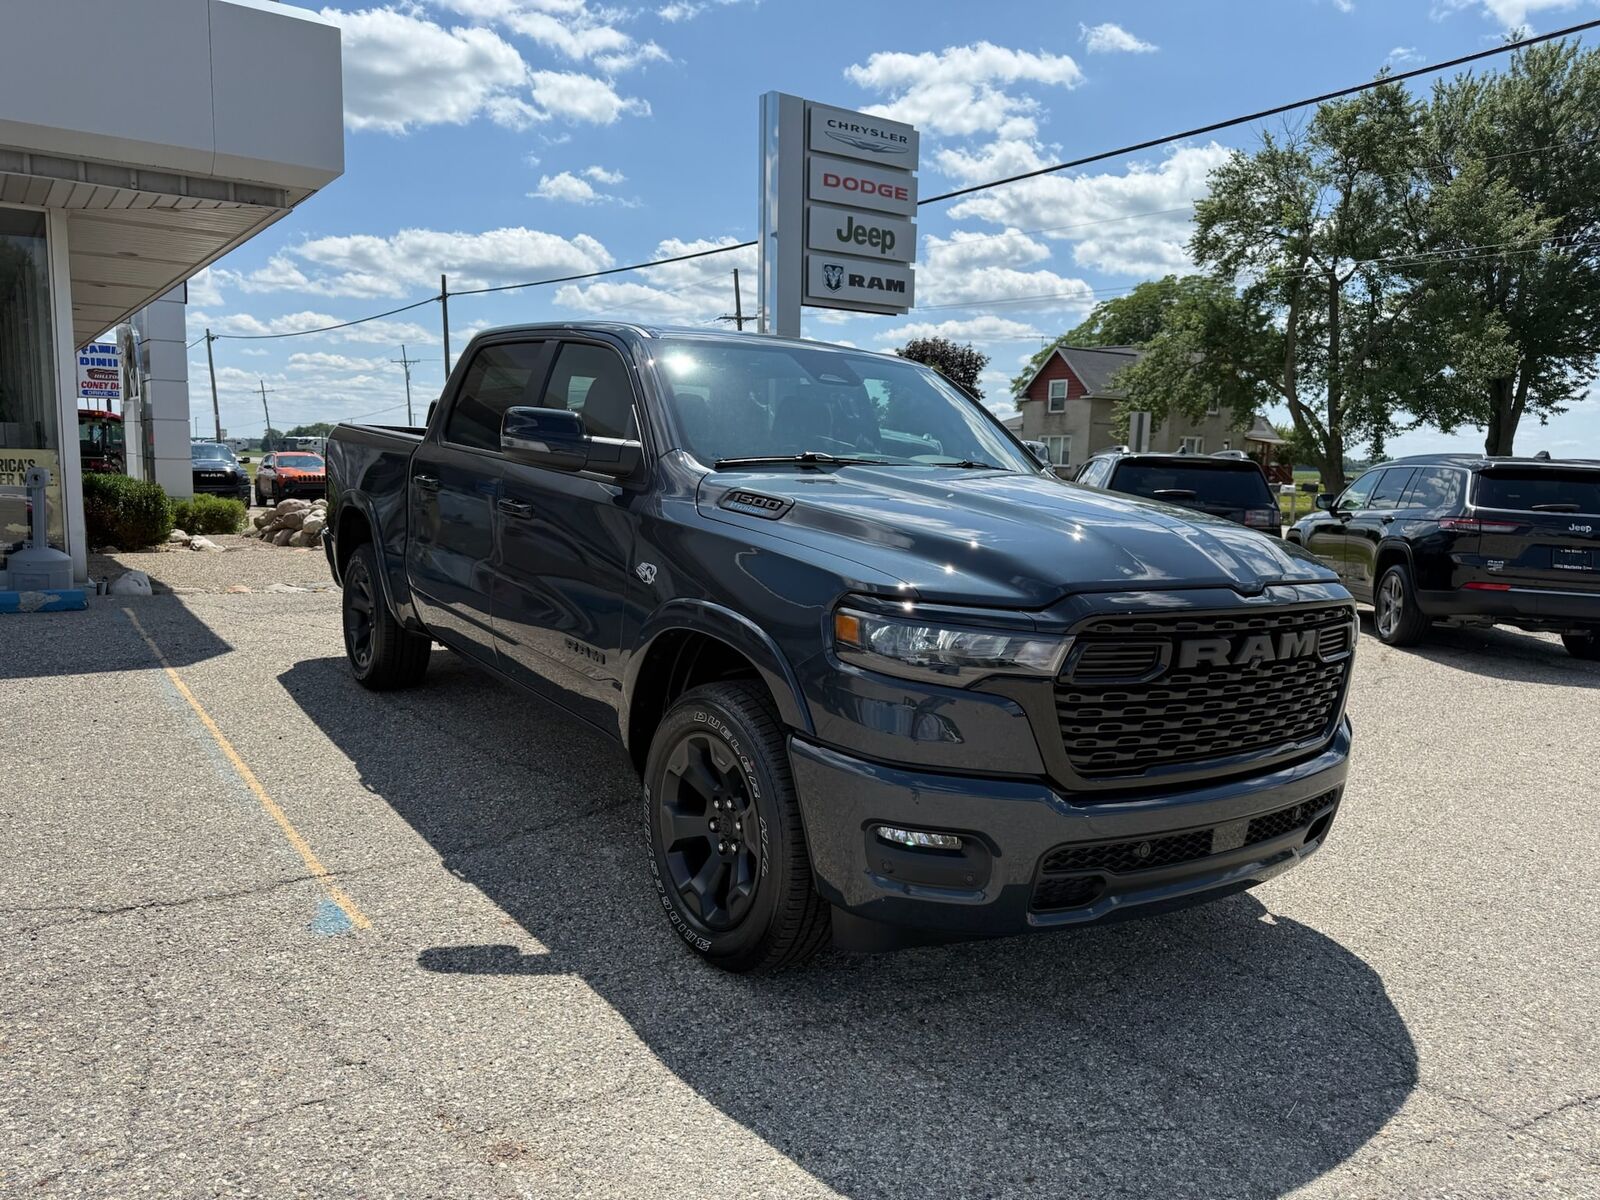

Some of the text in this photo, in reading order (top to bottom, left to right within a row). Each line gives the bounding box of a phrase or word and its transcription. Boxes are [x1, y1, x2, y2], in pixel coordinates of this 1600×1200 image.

[827, 119, 908, 144] CHRYSLER
[823, 173, 908, 200] DODGE
[837, 216, 895, 254] Jeep
[848, 274, 905, 293] RAM
[81, 381, 109, 389] CONEY
[734, 492, 781, 511] 1500
[1568, 523, 1592, 533] Jeep
[1178, 629, 1317, 669] RAM
[693, 711, 761, 800] DUELER
